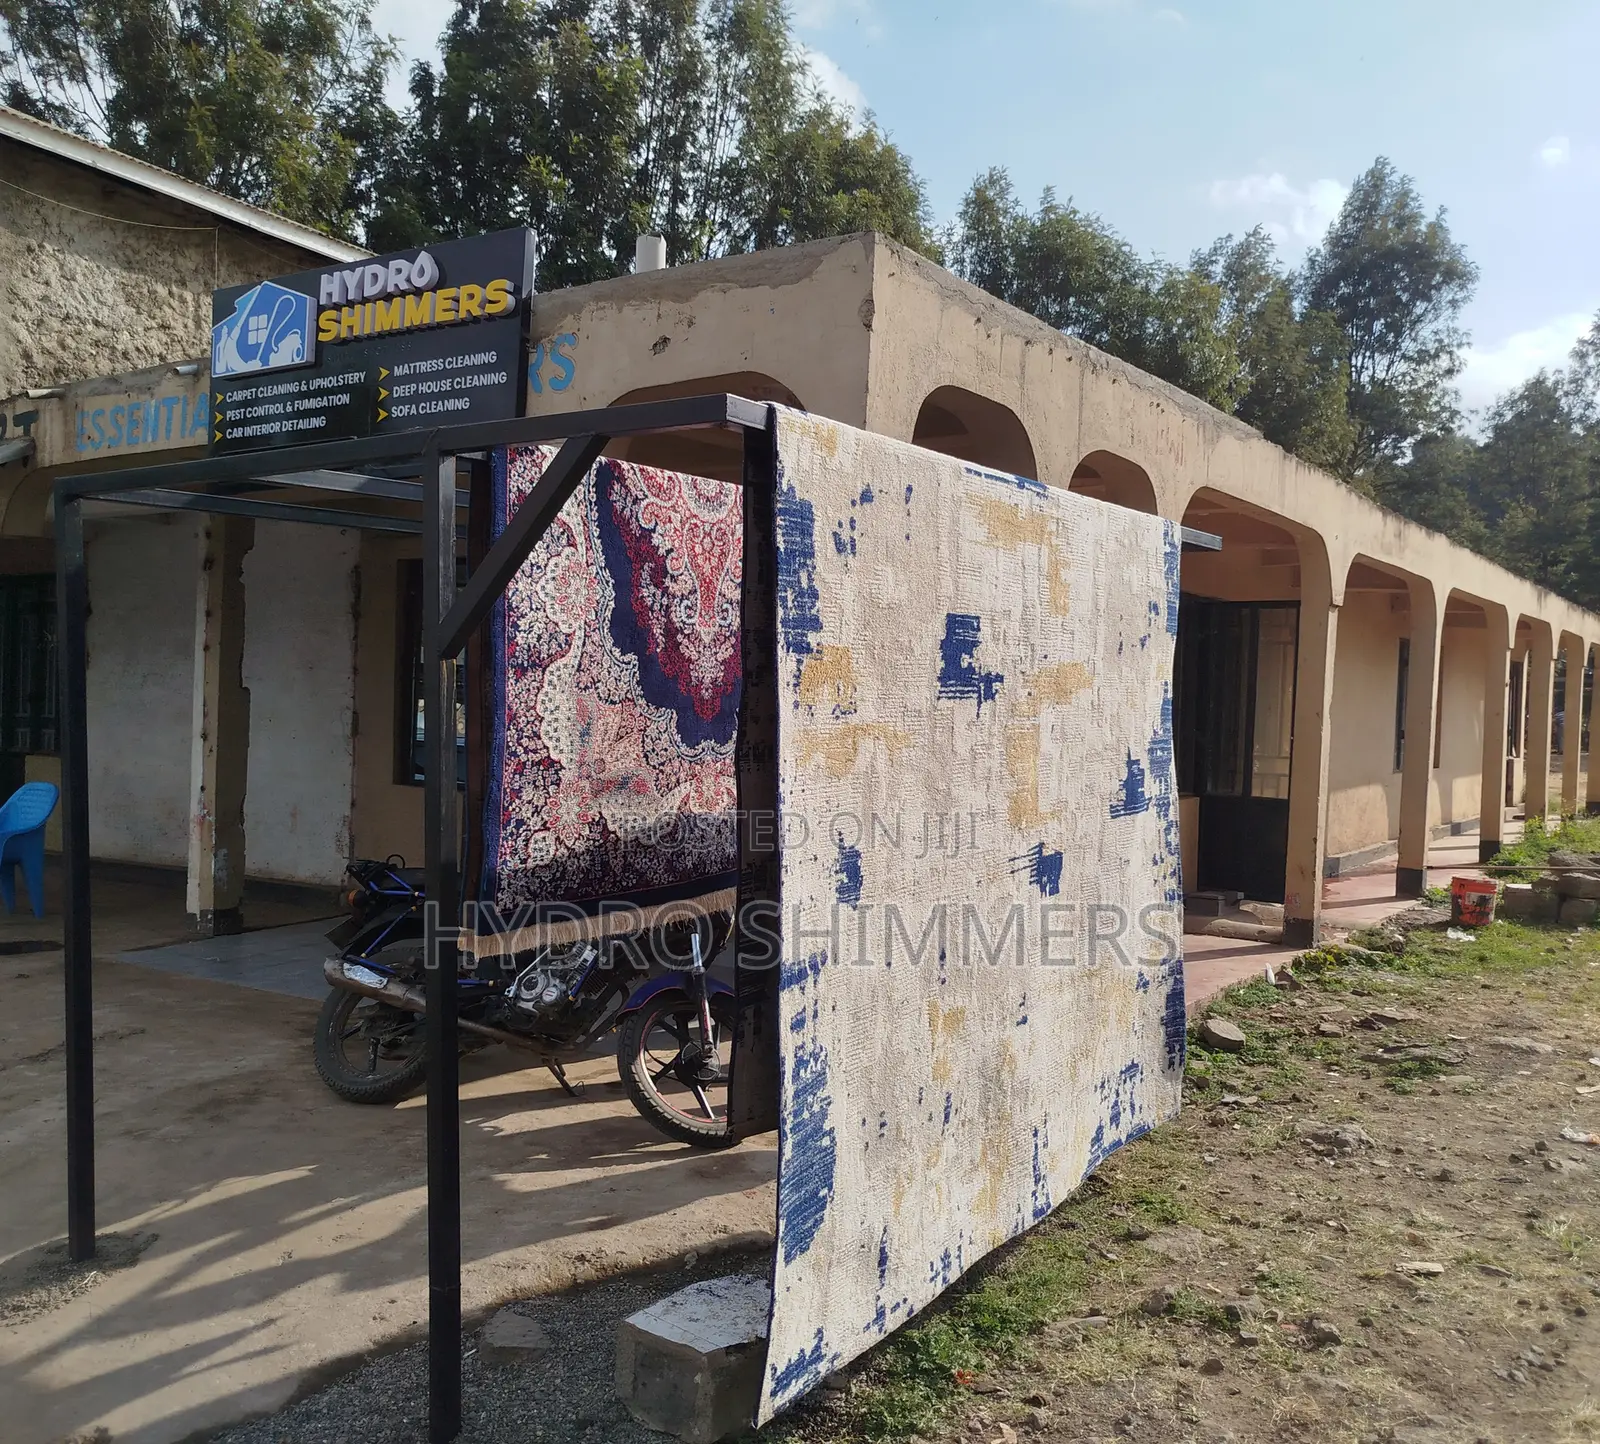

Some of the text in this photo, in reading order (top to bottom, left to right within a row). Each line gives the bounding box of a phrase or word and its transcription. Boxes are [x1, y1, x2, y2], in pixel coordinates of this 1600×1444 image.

[319, 251, 439, 306] HYDRO
[318, 279, 514, 342] SHIMMERS
[394, 351, 498, 377] MATTRESS CLEANING
[226, 371, 366, 403] CARPET CLEANING & UPHOLSTERY
[393, 371, 507, 398] DEEP HOUSE CLEANING
[226, 393, 350, 422] PEST CONTROL & FUMIGATION
[391, 397, 470, 418] SOFA CLEANING
[76, 393, 209, 452] ESSENTIA
[226, 416, 327, 439] CAR INTERIOR DETAILING
